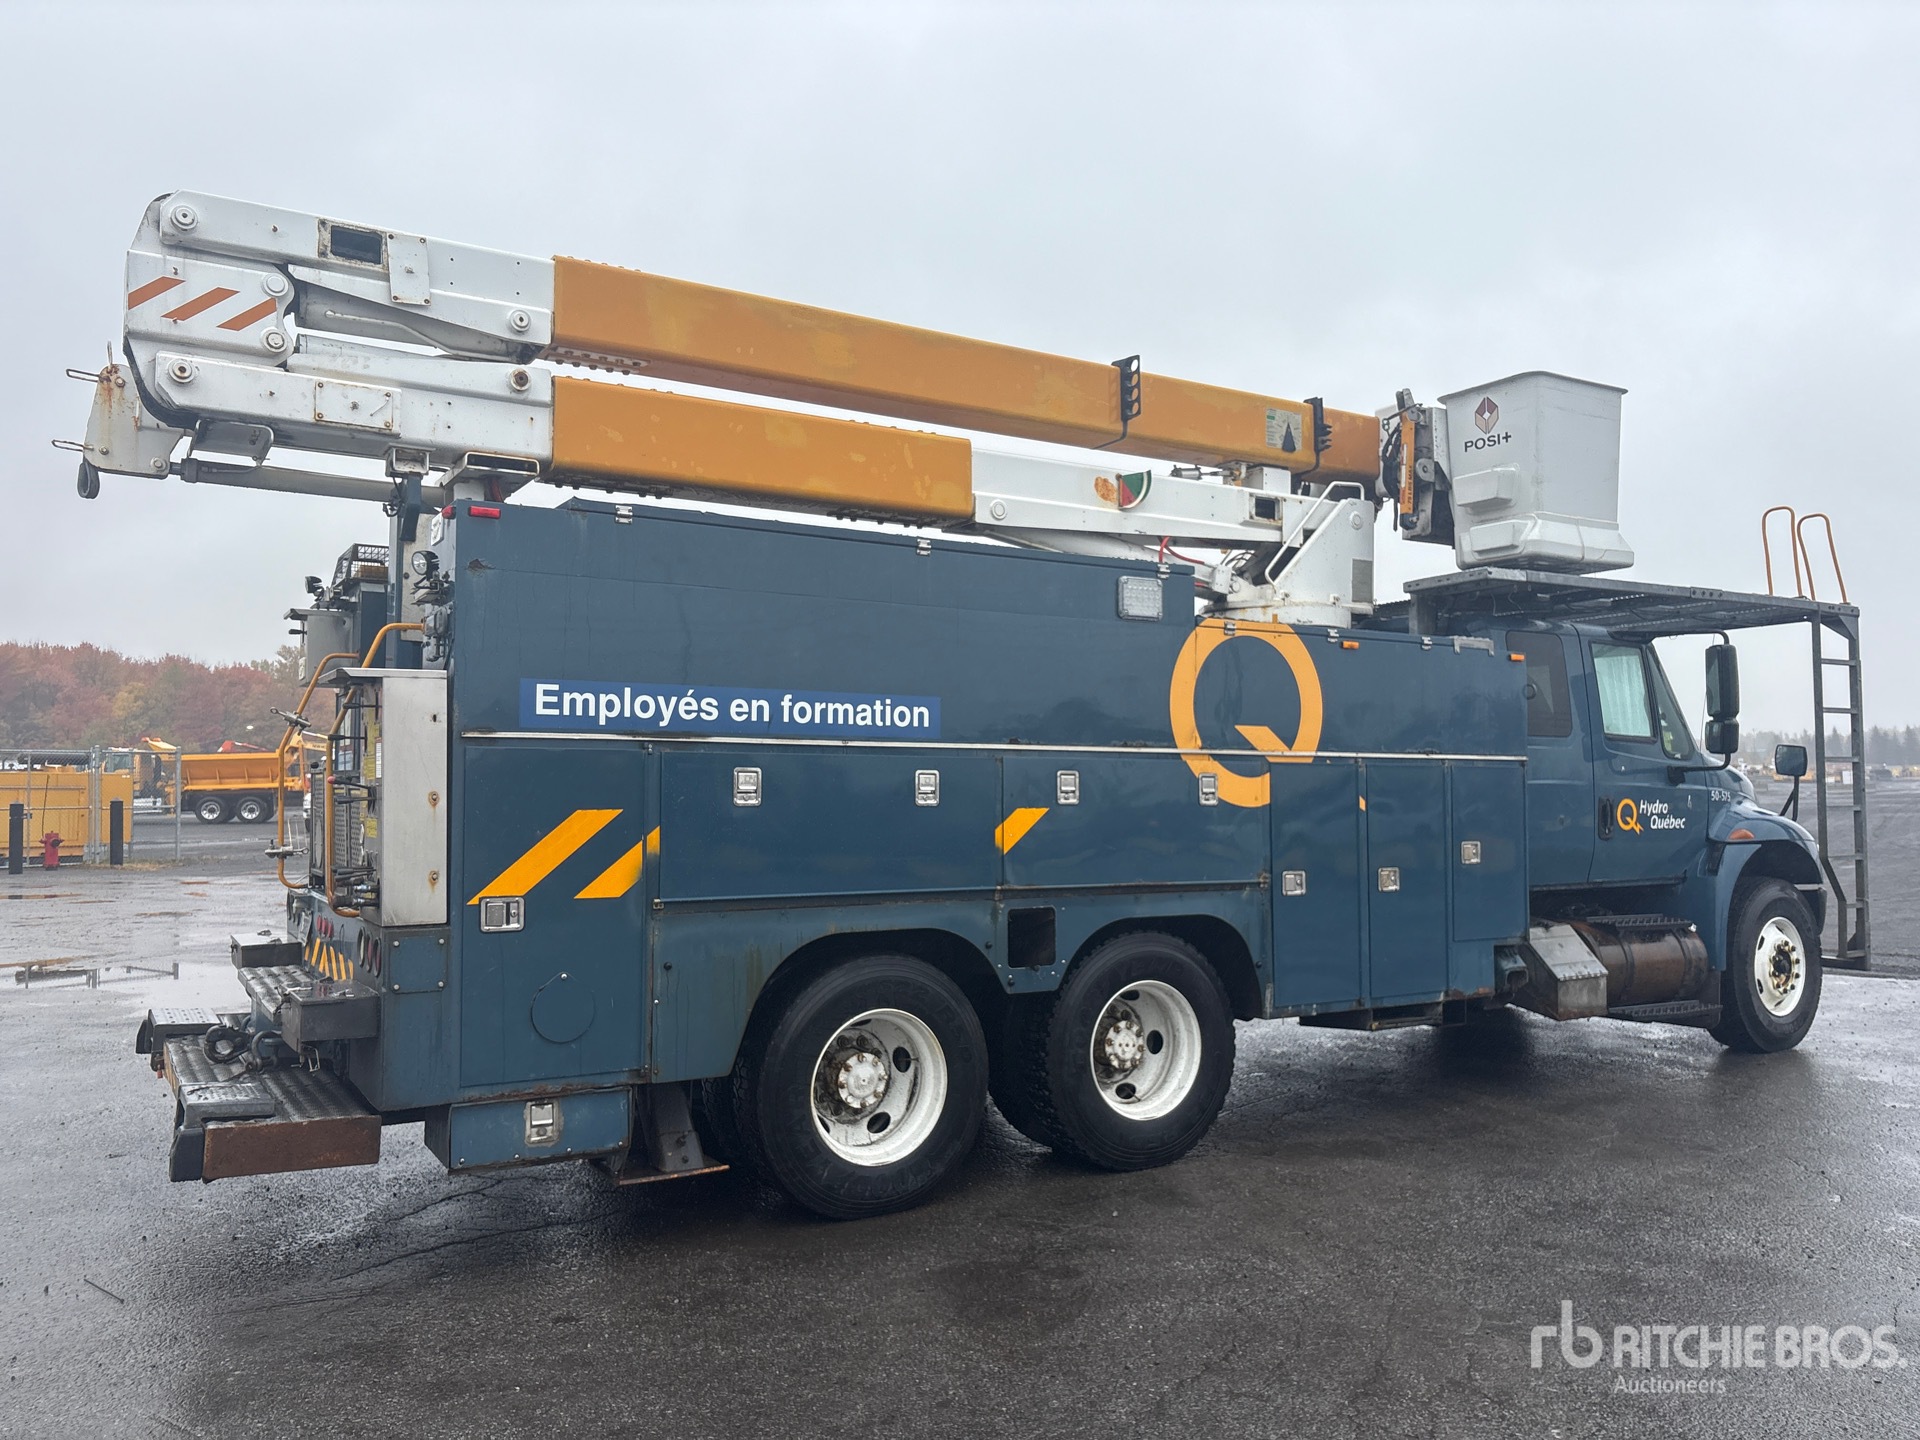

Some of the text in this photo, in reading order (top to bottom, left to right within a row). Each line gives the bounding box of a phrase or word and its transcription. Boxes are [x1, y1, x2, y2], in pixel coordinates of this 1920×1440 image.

[1464, 431, 1512, 452] POSI+
[534, 683, 930, 727] Employés en formation
[1711, 790, 1731, 802] 50-575
[1639, 799, 1669, 817] Hydro
[1650, 814, 1686, 830] Québec
